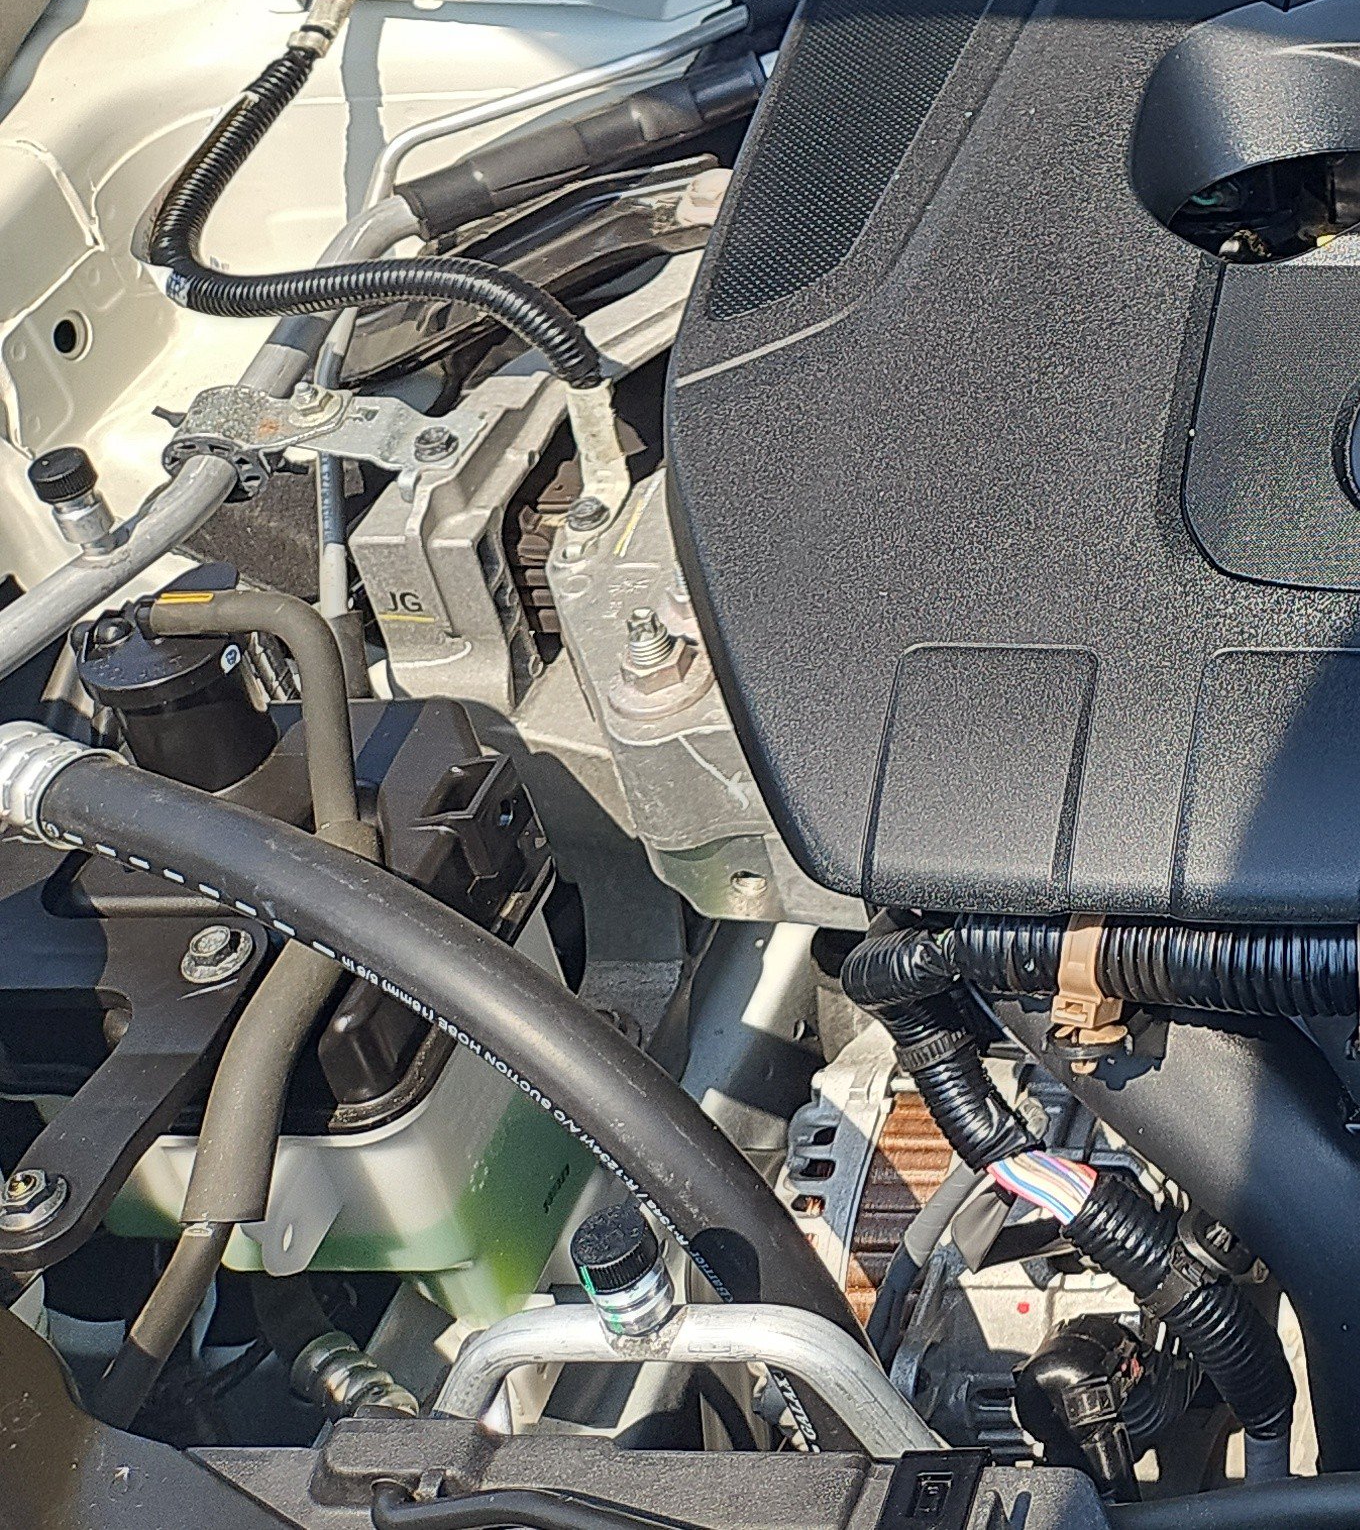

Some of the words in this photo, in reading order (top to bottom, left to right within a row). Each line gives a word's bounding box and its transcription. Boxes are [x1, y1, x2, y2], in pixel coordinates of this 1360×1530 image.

[381, 979, 434, 1021] (16mm)
[438, 1016, 482, 1054] HOSE
[483, 1050, 552, 1109] SUCTION
[553, 1109, 581, 1133] A/C
[579, 1133, 639, 1191] R-1234yf
[646, 1199, 689, 1246] R-134a
